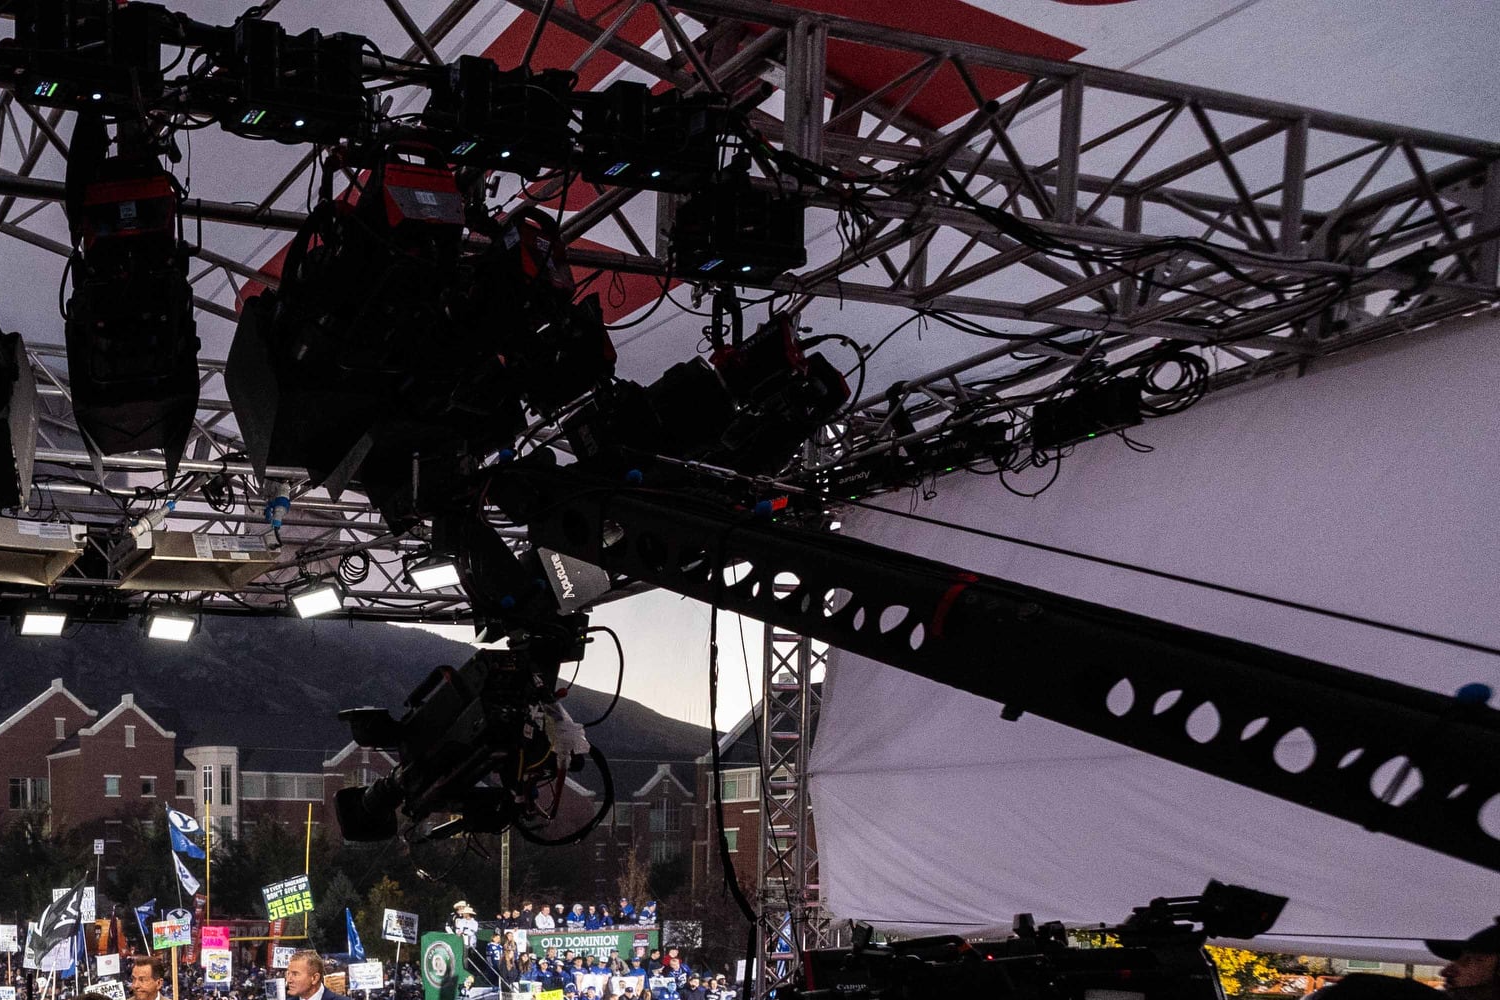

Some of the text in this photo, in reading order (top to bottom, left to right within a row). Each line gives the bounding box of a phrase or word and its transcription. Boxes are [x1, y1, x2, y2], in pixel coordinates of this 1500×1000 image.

[284, 885, 298, 895] GIVE
[269, 898, 314, 921] JESUS
[541, 937, 562, 948] OLD
[565, 935, 619, 947] DOMINION
